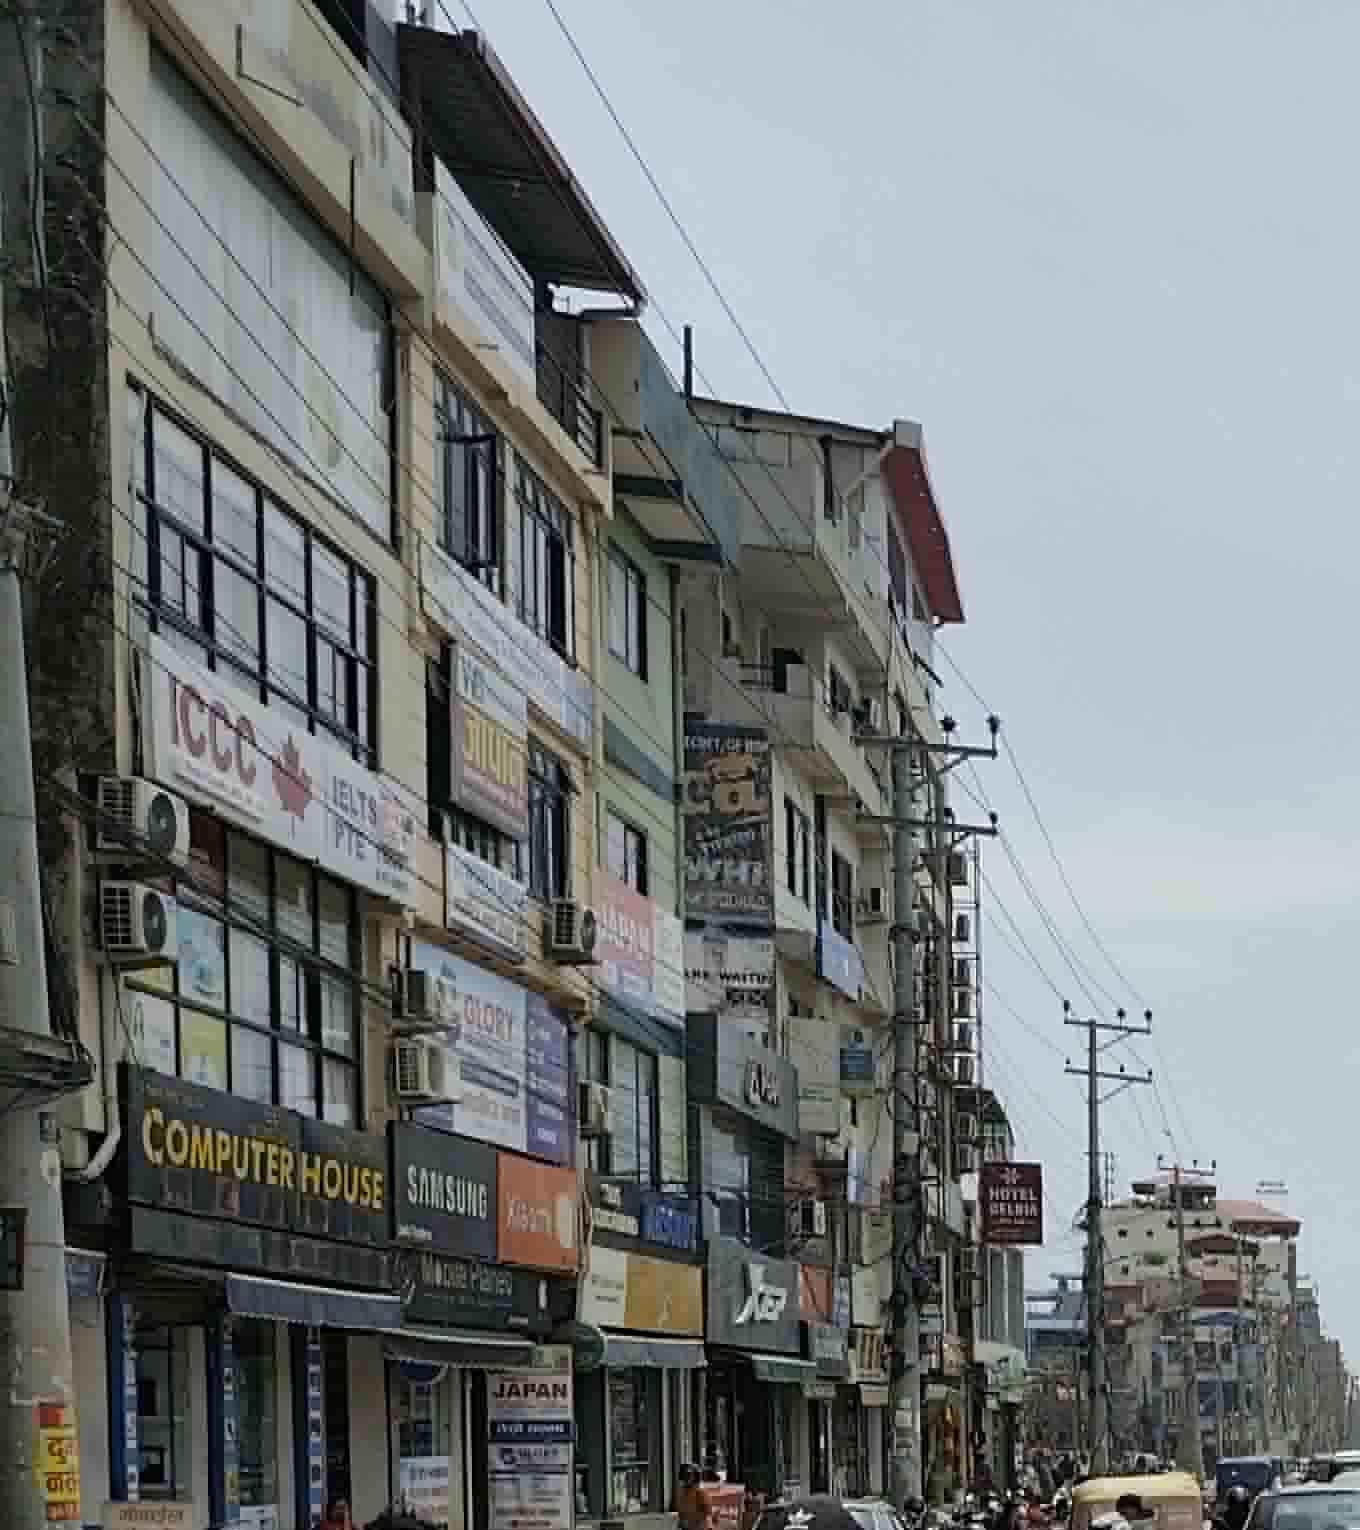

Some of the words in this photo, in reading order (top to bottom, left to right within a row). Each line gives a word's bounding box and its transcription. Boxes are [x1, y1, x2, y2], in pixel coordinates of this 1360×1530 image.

[142, 1105, 294, 1189] COMPUTER
[302, 1152, 385, 1209] HOUSE
[407, 1163, 488, 1221] SAMSUNG
[988, 1186, 1039, 1201] HOTEL
[495, 1383, 567, 1399] JAPAN
